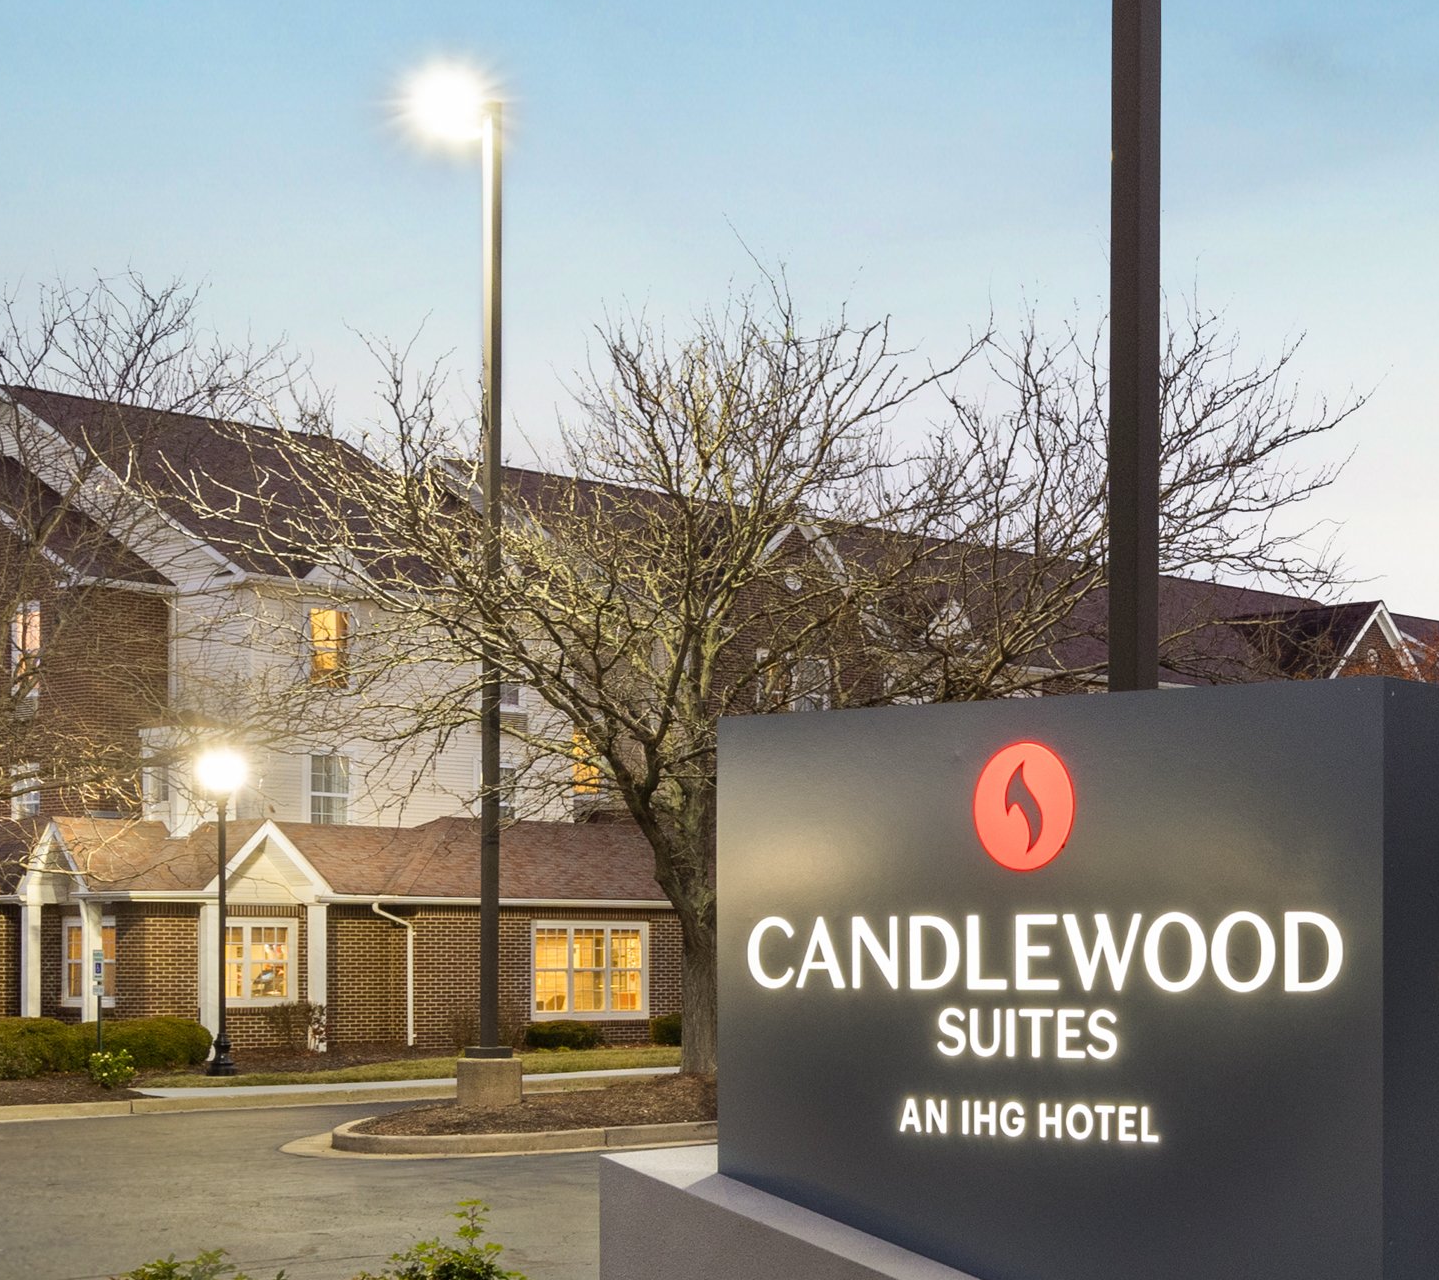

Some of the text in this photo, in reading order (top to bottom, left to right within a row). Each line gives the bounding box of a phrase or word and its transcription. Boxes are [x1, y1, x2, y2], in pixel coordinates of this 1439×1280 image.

[747, 910, 1345, 993] CANDLEWOOD
[936, 1007, 1119, 1060] SUITES
[899, 1098, 1160, 1143] AN IHG HOTEL
